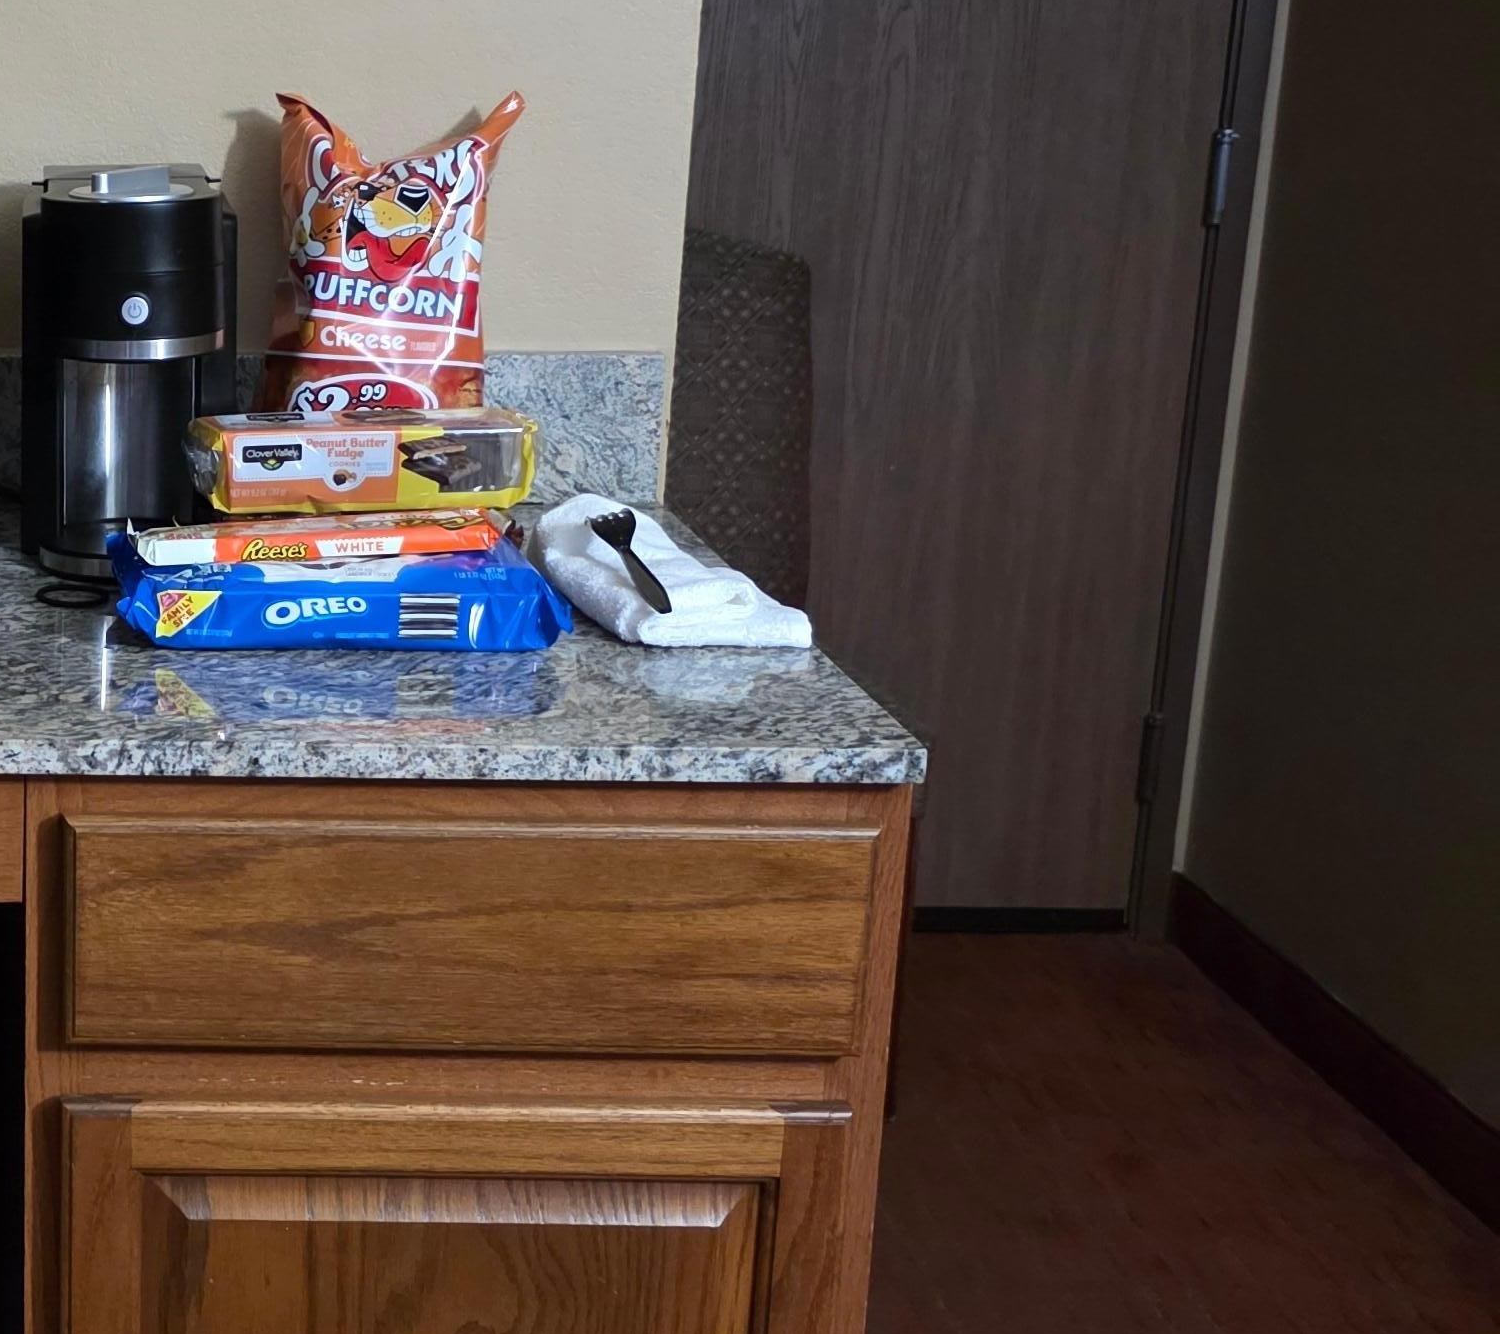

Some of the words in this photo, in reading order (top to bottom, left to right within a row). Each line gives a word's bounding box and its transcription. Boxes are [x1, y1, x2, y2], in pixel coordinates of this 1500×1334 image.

[319, 324, 408, 352] Cheese
[245, 448, 273, 459] Clover
[273, 446, 300, 459] Valley
[306, 438, 349, 449] Peanut
[350, 437, 388, 448] Butter
[327, 447, 365, 460] Fudge
[242, 537, 308, 561] Reese's
[335, 541, 385, 554] WHITE
[161, 595, 195, 625] FAMILY
[264, 596, 368, 627] OREO
